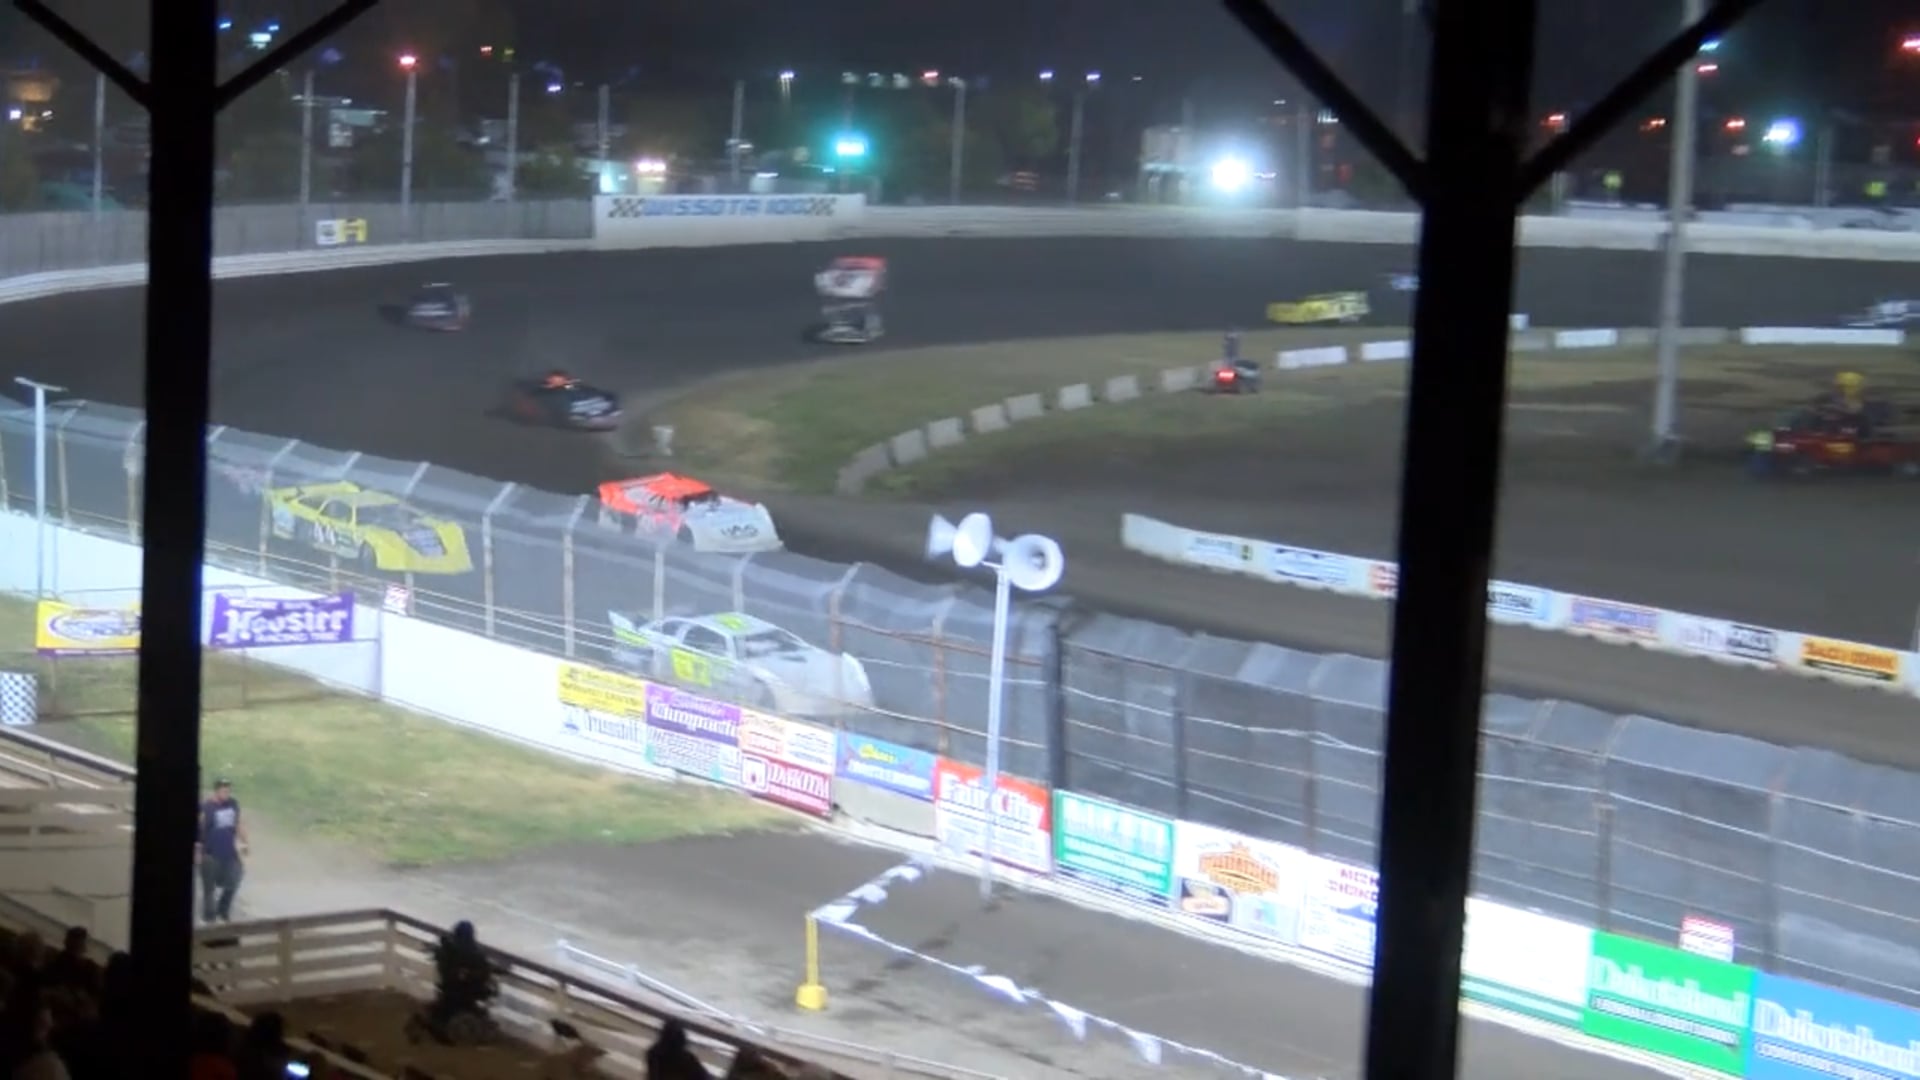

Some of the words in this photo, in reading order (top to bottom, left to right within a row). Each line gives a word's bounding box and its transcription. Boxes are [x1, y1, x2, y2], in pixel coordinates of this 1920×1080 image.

[643, 198, 761, 217] WISSOTA
[215, 609, 348, 644] Hoosier
[940, 772, 988, 812] Fair
[991, 786, 1044, 828] City
